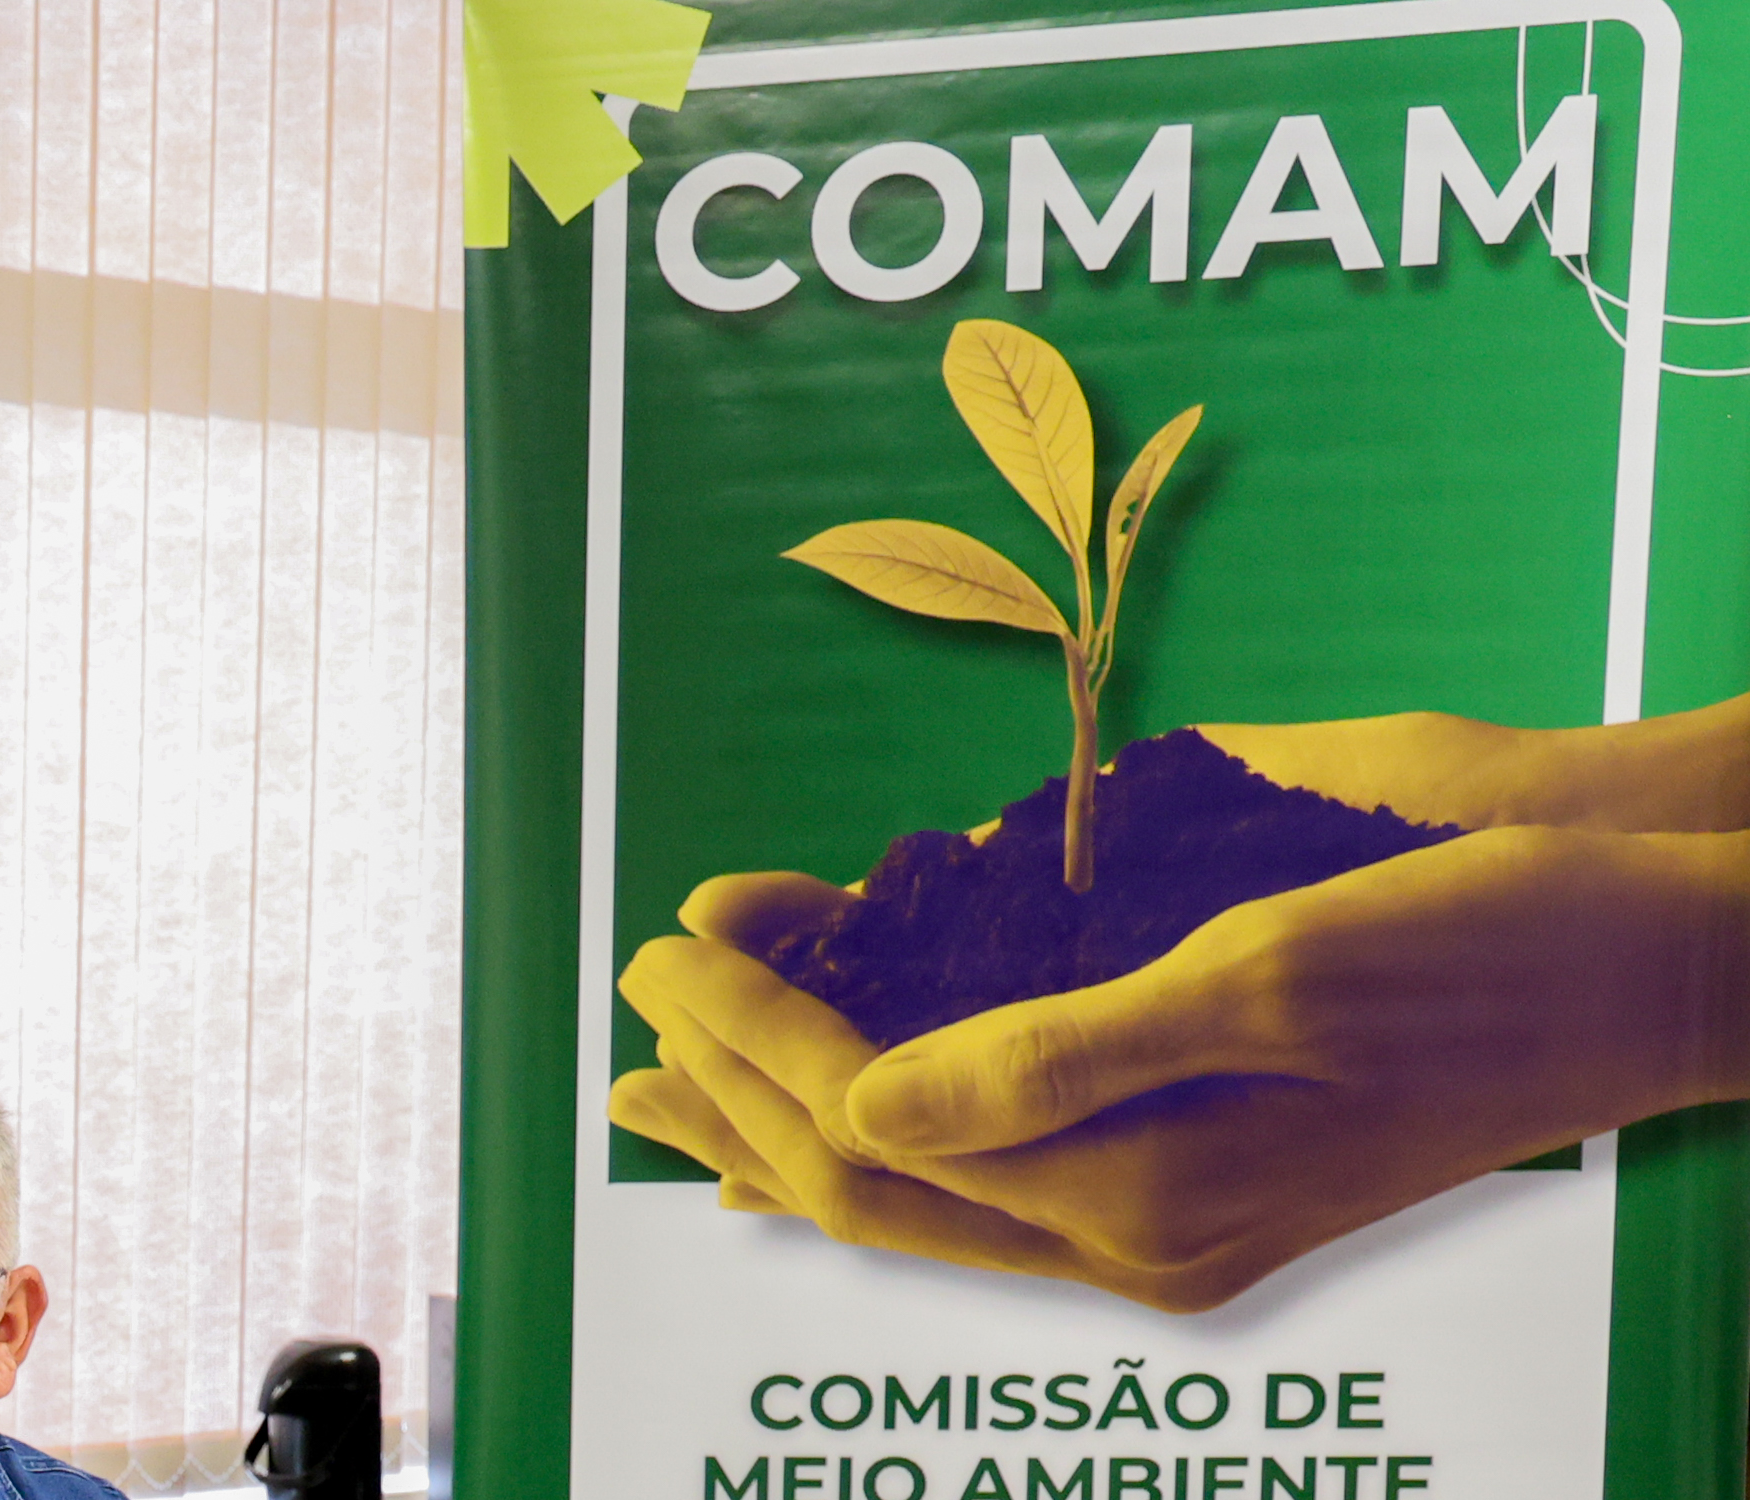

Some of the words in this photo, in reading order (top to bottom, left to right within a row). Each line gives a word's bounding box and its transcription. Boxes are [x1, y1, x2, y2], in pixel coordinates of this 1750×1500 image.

[655, 93, 1598, 313] COMAM
[750, 1358, 1229, 1431] COMISSÃO
[1265, 1371, 1386, 1430] DE
